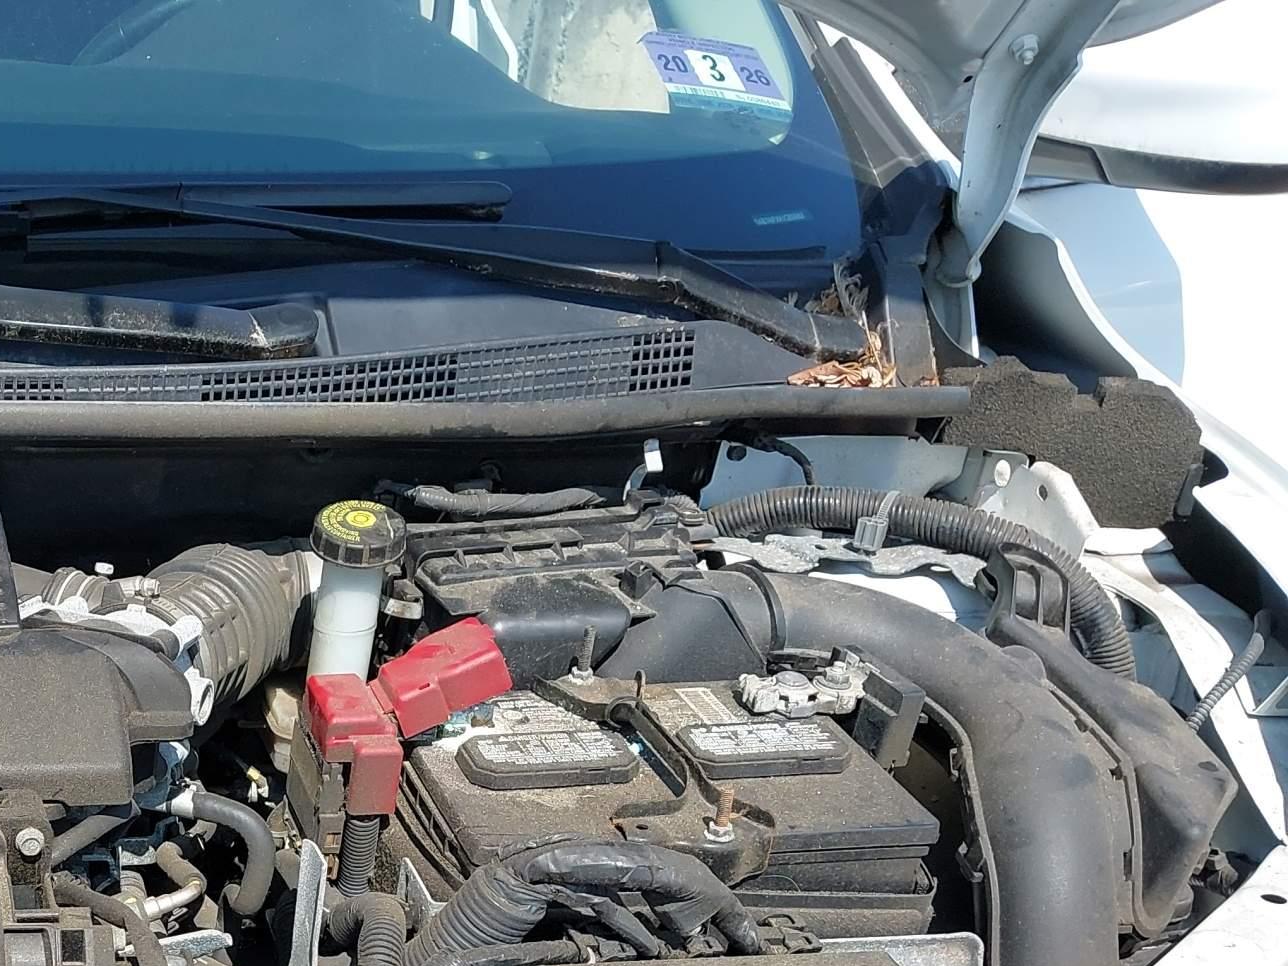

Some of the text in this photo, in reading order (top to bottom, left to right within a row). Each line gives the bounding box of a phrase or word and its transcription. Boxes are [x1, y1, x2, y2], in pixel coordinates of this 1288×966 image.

[658, 54, 770, 86] 20 3 26
